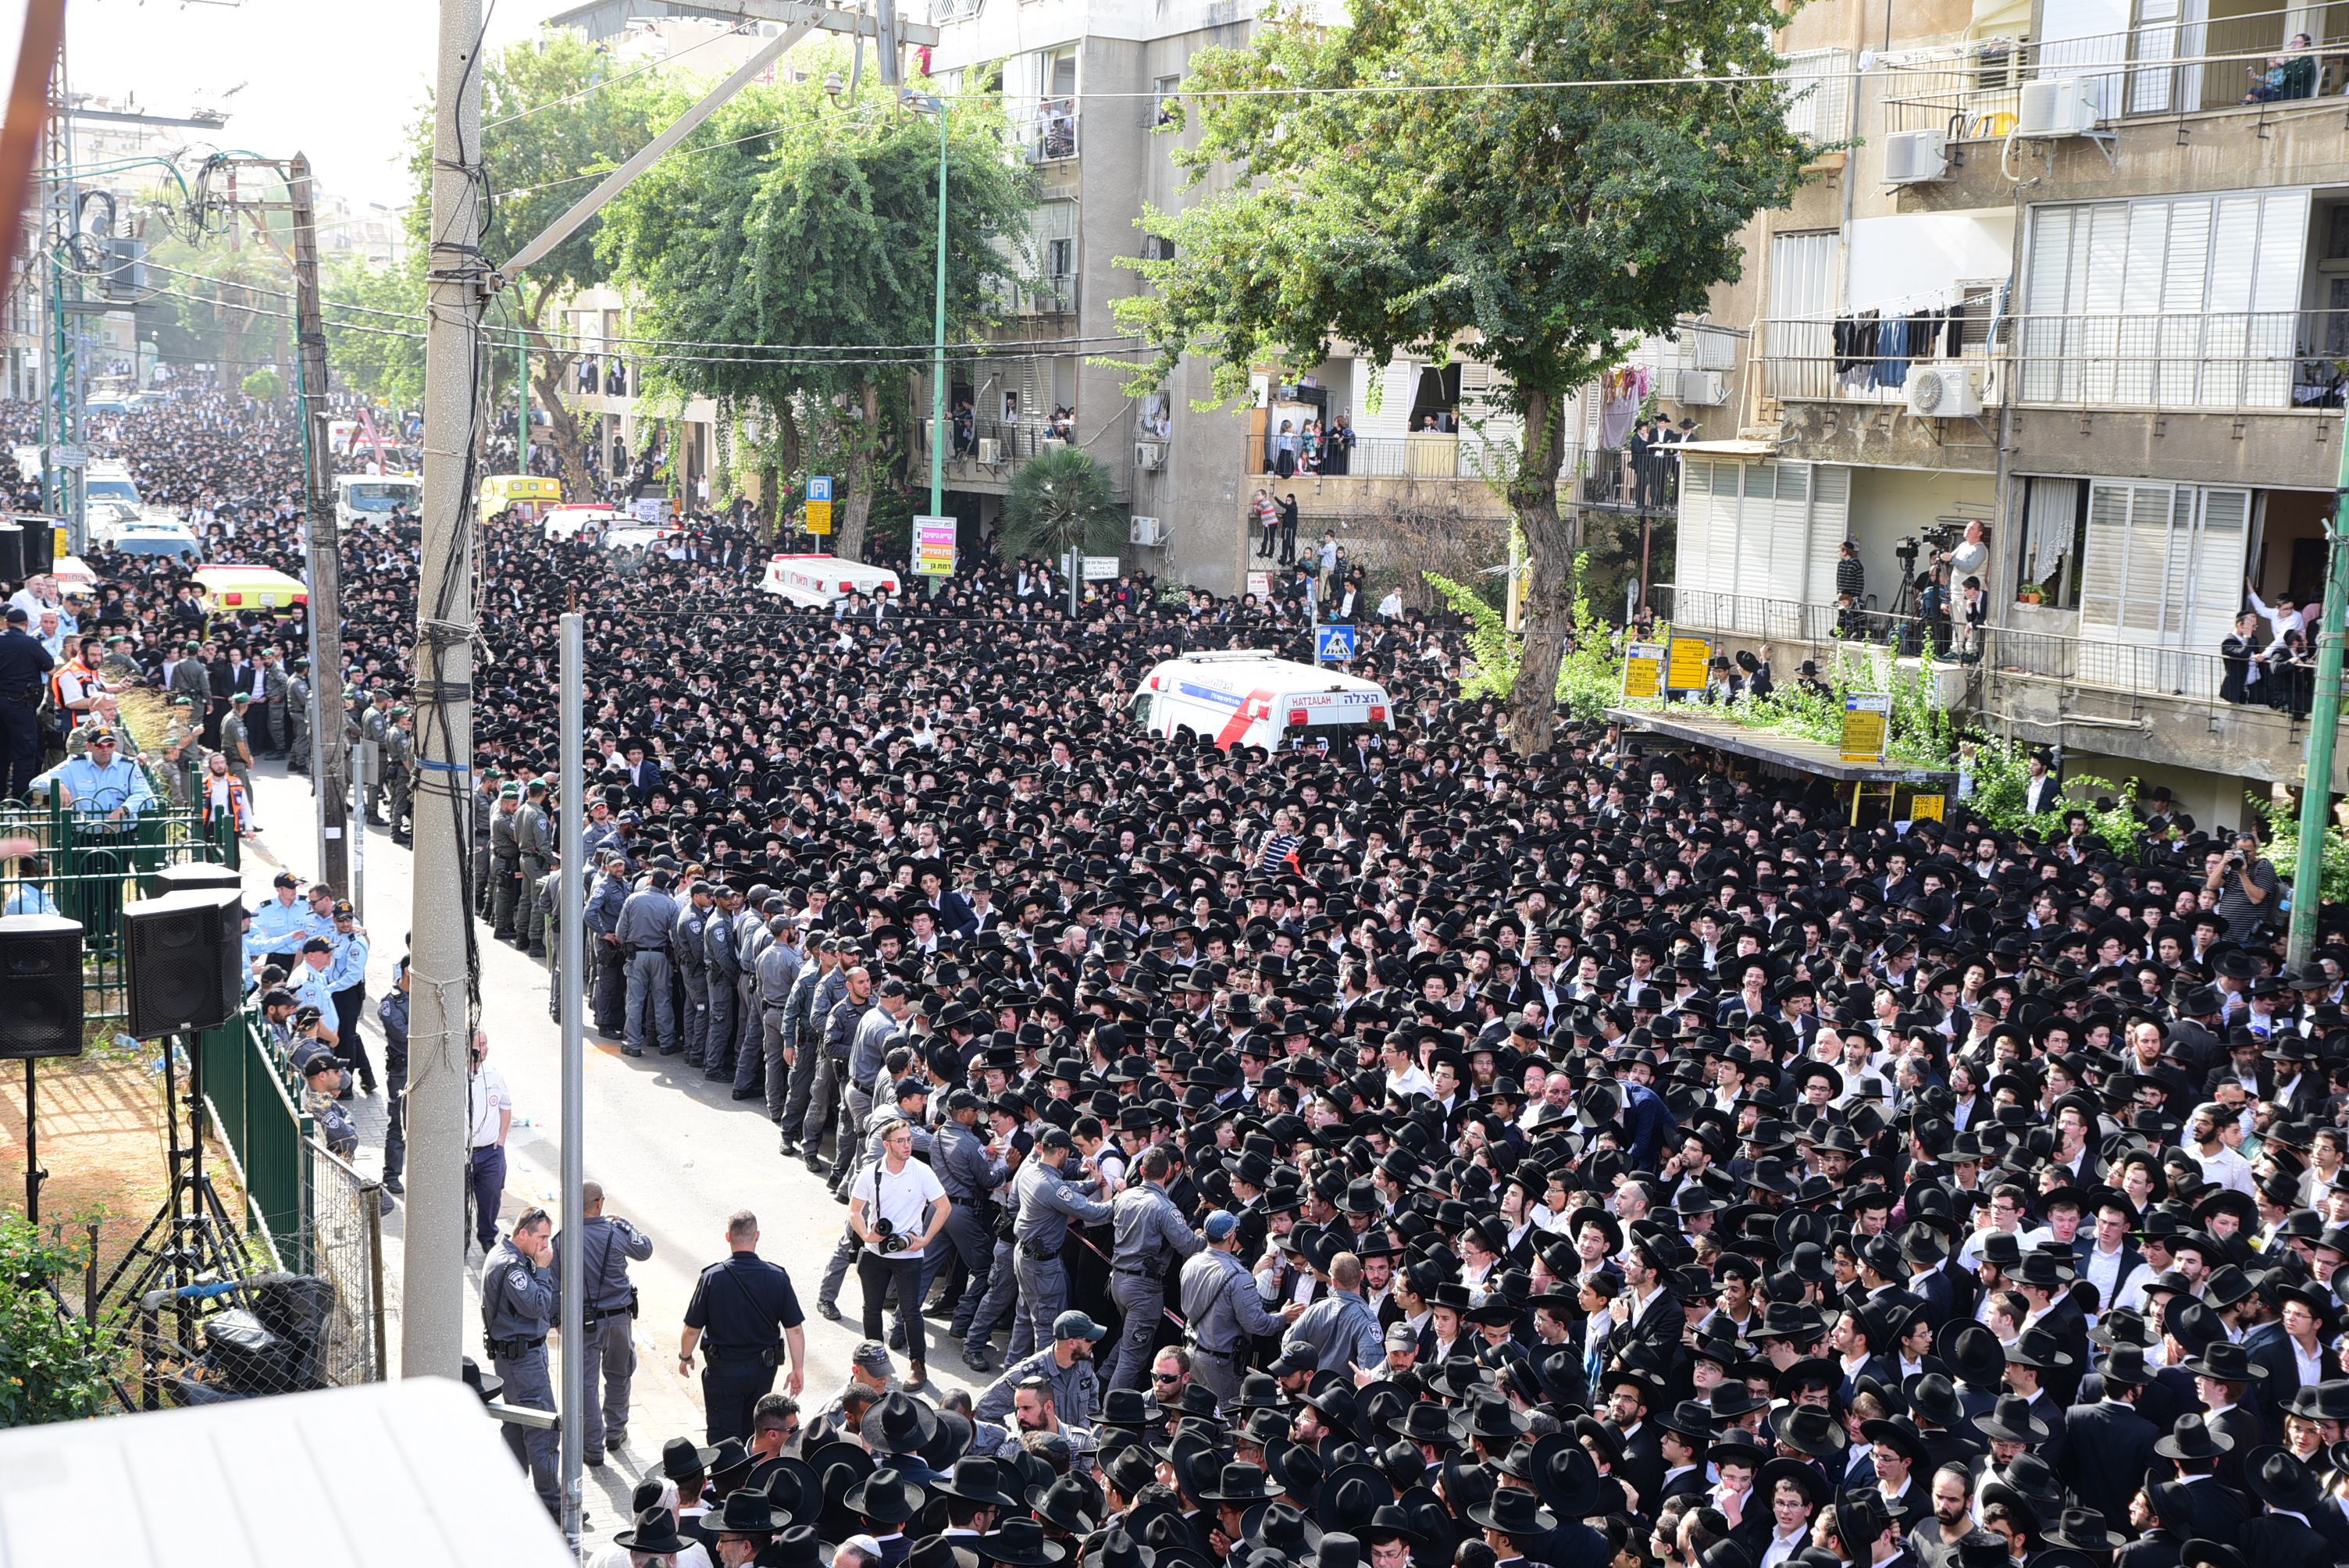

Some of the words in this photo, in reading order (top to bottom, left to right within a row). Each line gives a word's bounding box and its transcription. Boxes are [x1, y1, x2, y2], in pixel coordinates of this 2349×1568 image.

[1214, 678, 1234, 691] הצלה
[1292, 696, 1331, 707] HATZALAH
[1344, 693, 1379, 704] הצלה
[1005, 1377, 1017, 1390] POLIC
